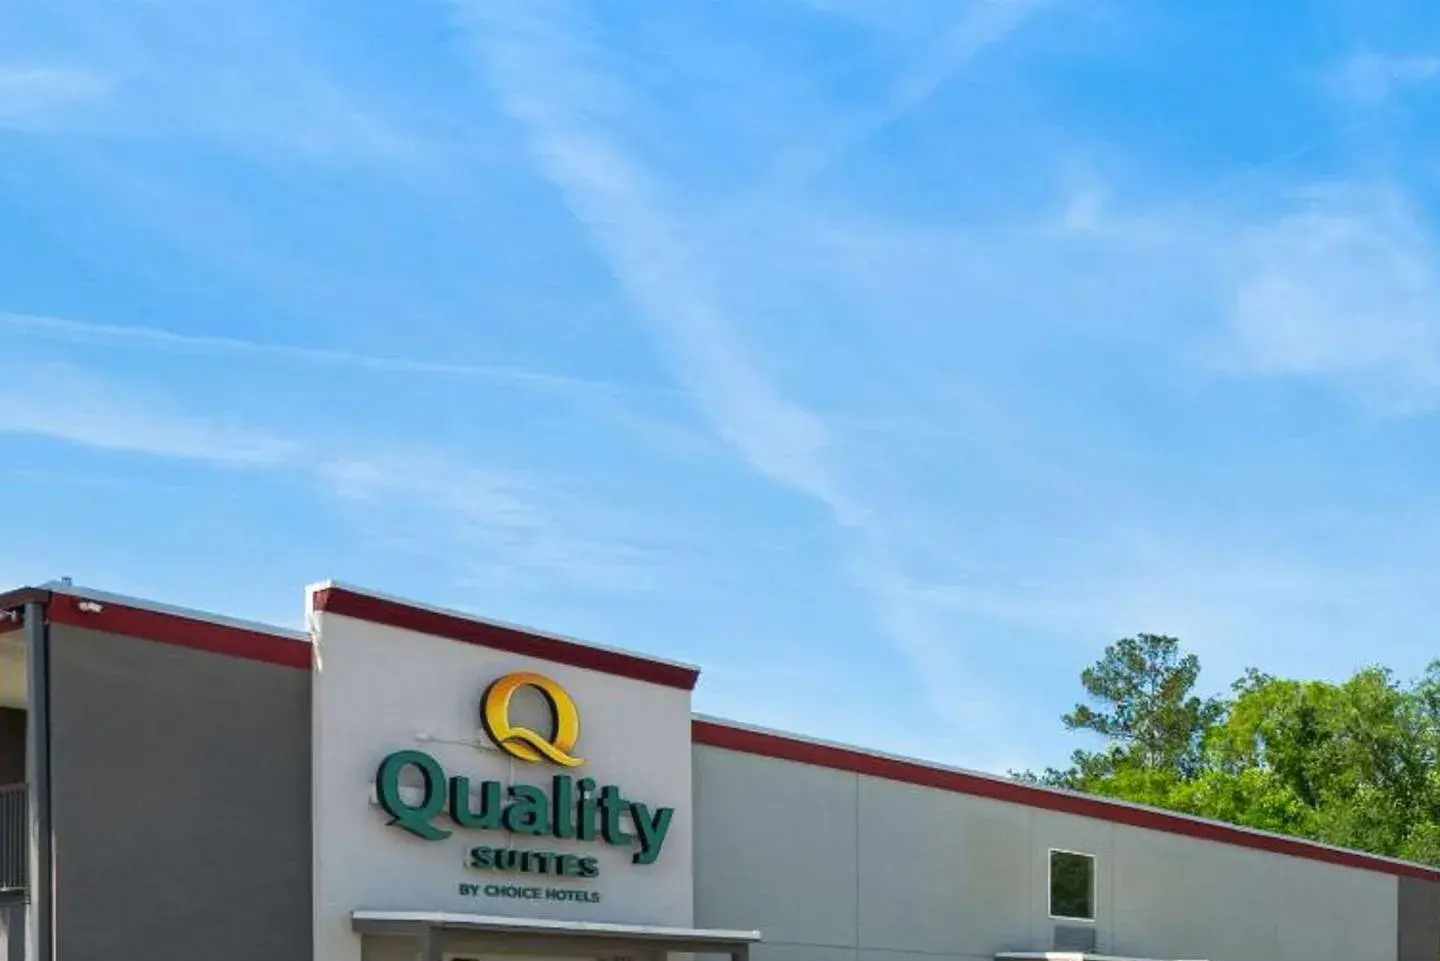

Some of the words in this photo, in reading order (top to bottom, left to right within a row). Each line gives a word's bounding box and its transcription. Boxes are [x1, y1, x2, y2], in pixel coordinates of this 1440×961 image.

[480, 671, 585, 768] Q
[376, 750, 675, 865] Quality
[459, 883, 479, 896] BY
[484, 884, 542, 899] CHOICE
[545, 889, 600, 903] HOTELS
[470, 846, 600, 878] SUITES
